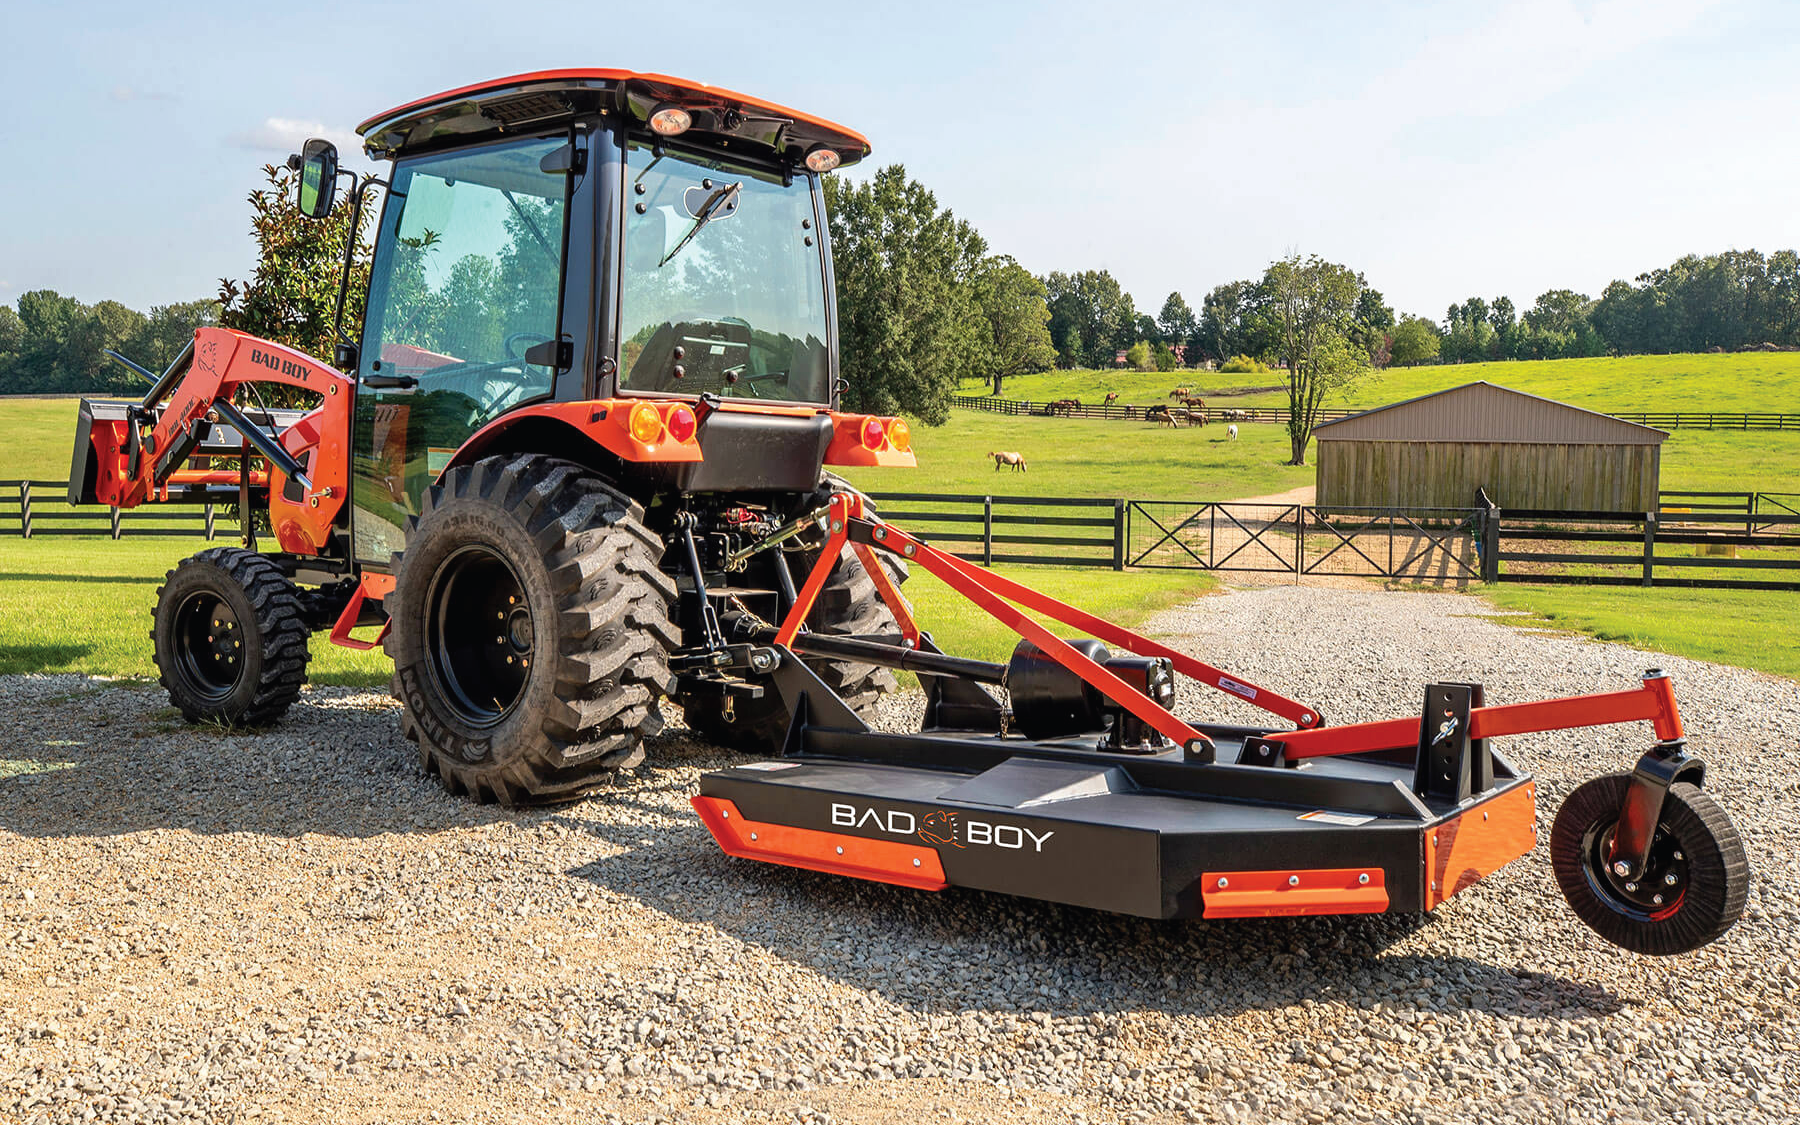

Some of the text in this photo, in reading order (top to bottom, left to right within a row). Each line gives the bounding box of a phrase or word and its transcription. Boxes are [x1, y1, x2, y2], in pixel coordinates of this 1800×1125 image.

[251, 349, 312, 381] BAD BOY
[403, 669, 456, 754] TIRON
[831, 802, 1054, 852] BAD BOY
